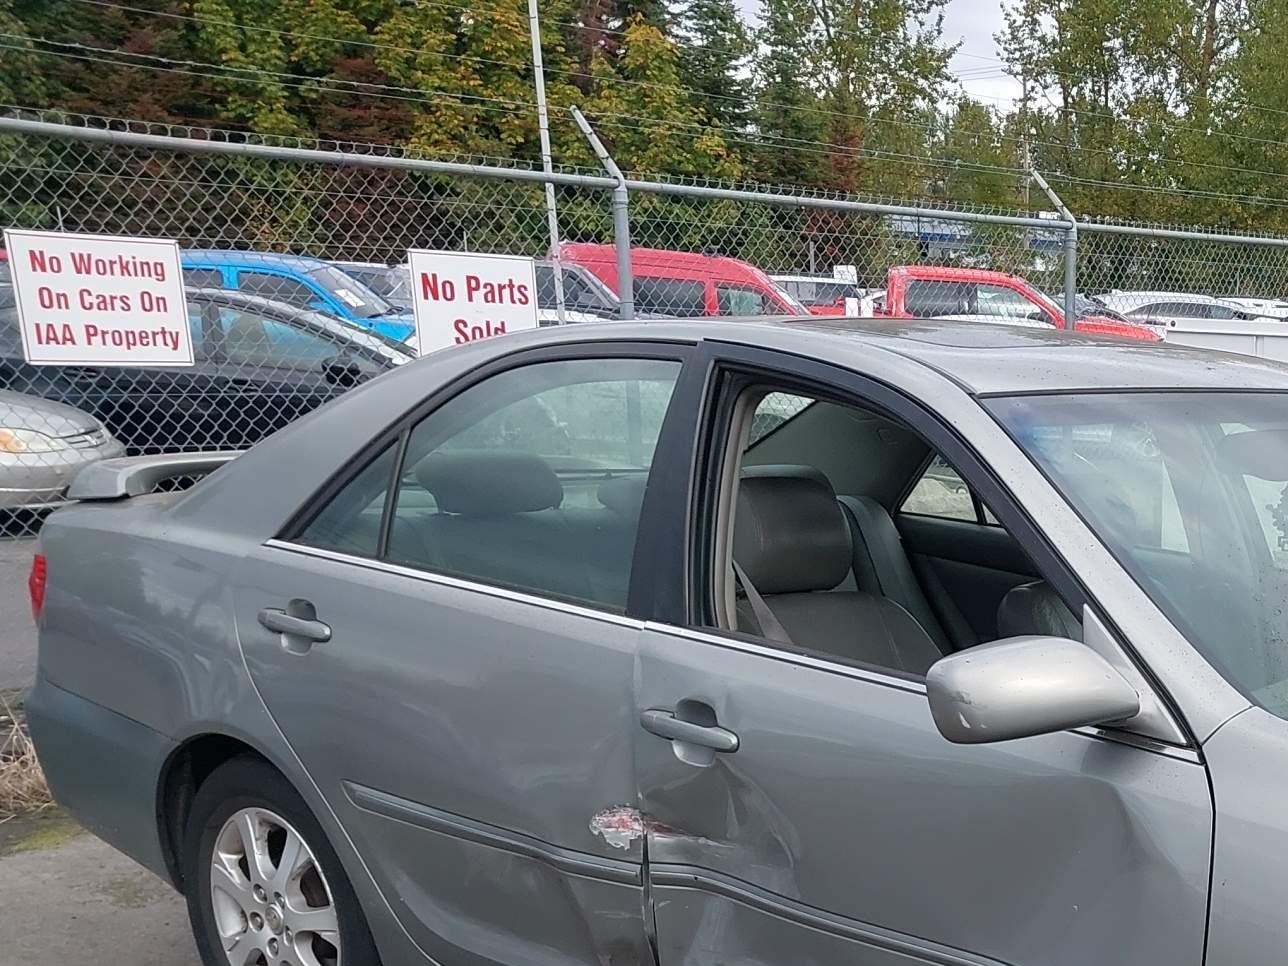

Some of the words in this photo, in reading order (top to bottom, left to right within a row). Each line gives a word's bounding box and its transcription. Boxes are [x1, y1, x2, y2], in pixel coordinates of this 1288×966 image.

[28, 249, 62, 274] No
[70, 251, 166, 282] Working
[38, 286, 70, 310] On
[79, 288, 131, 312] Cars
[140, 291, 168, 313] On
[421, 272, 455, 302] No
[465, 275, 529, 305] Parts
[35, 322, 77, 346] IAA
[84, 323, 180, 351] Property
